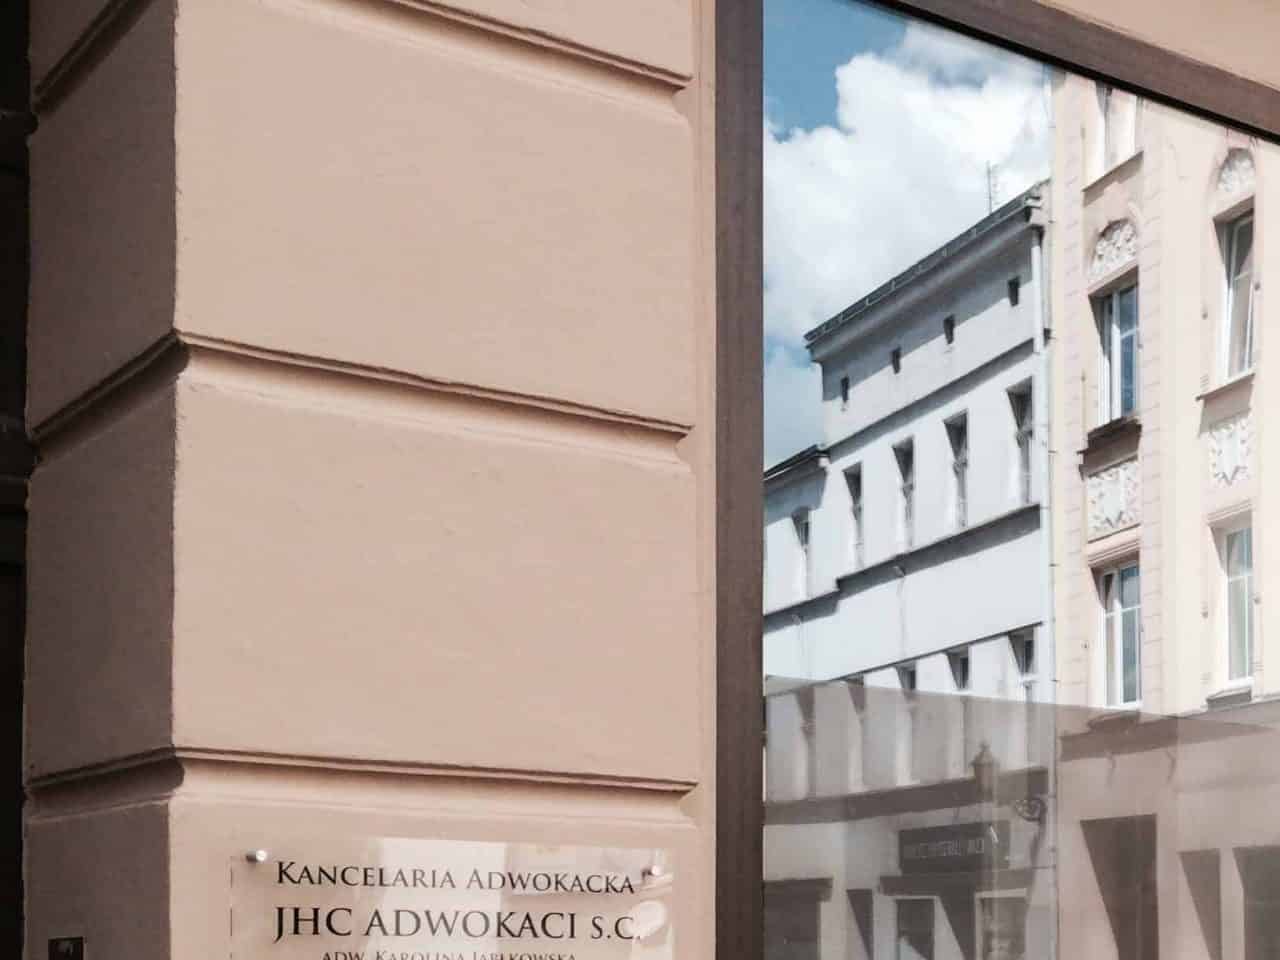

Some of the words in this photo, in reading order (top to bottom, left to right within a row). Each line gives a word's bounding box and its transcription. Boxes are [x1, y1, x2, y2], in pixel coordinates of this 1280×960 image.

[277, 861, 456, 888] KANCELARIA
[466, 867, 635, 894] ADWOKACKA
[273, 906, 353, 944] JHC
[363, 908, 577, 939] ADWOKACI
